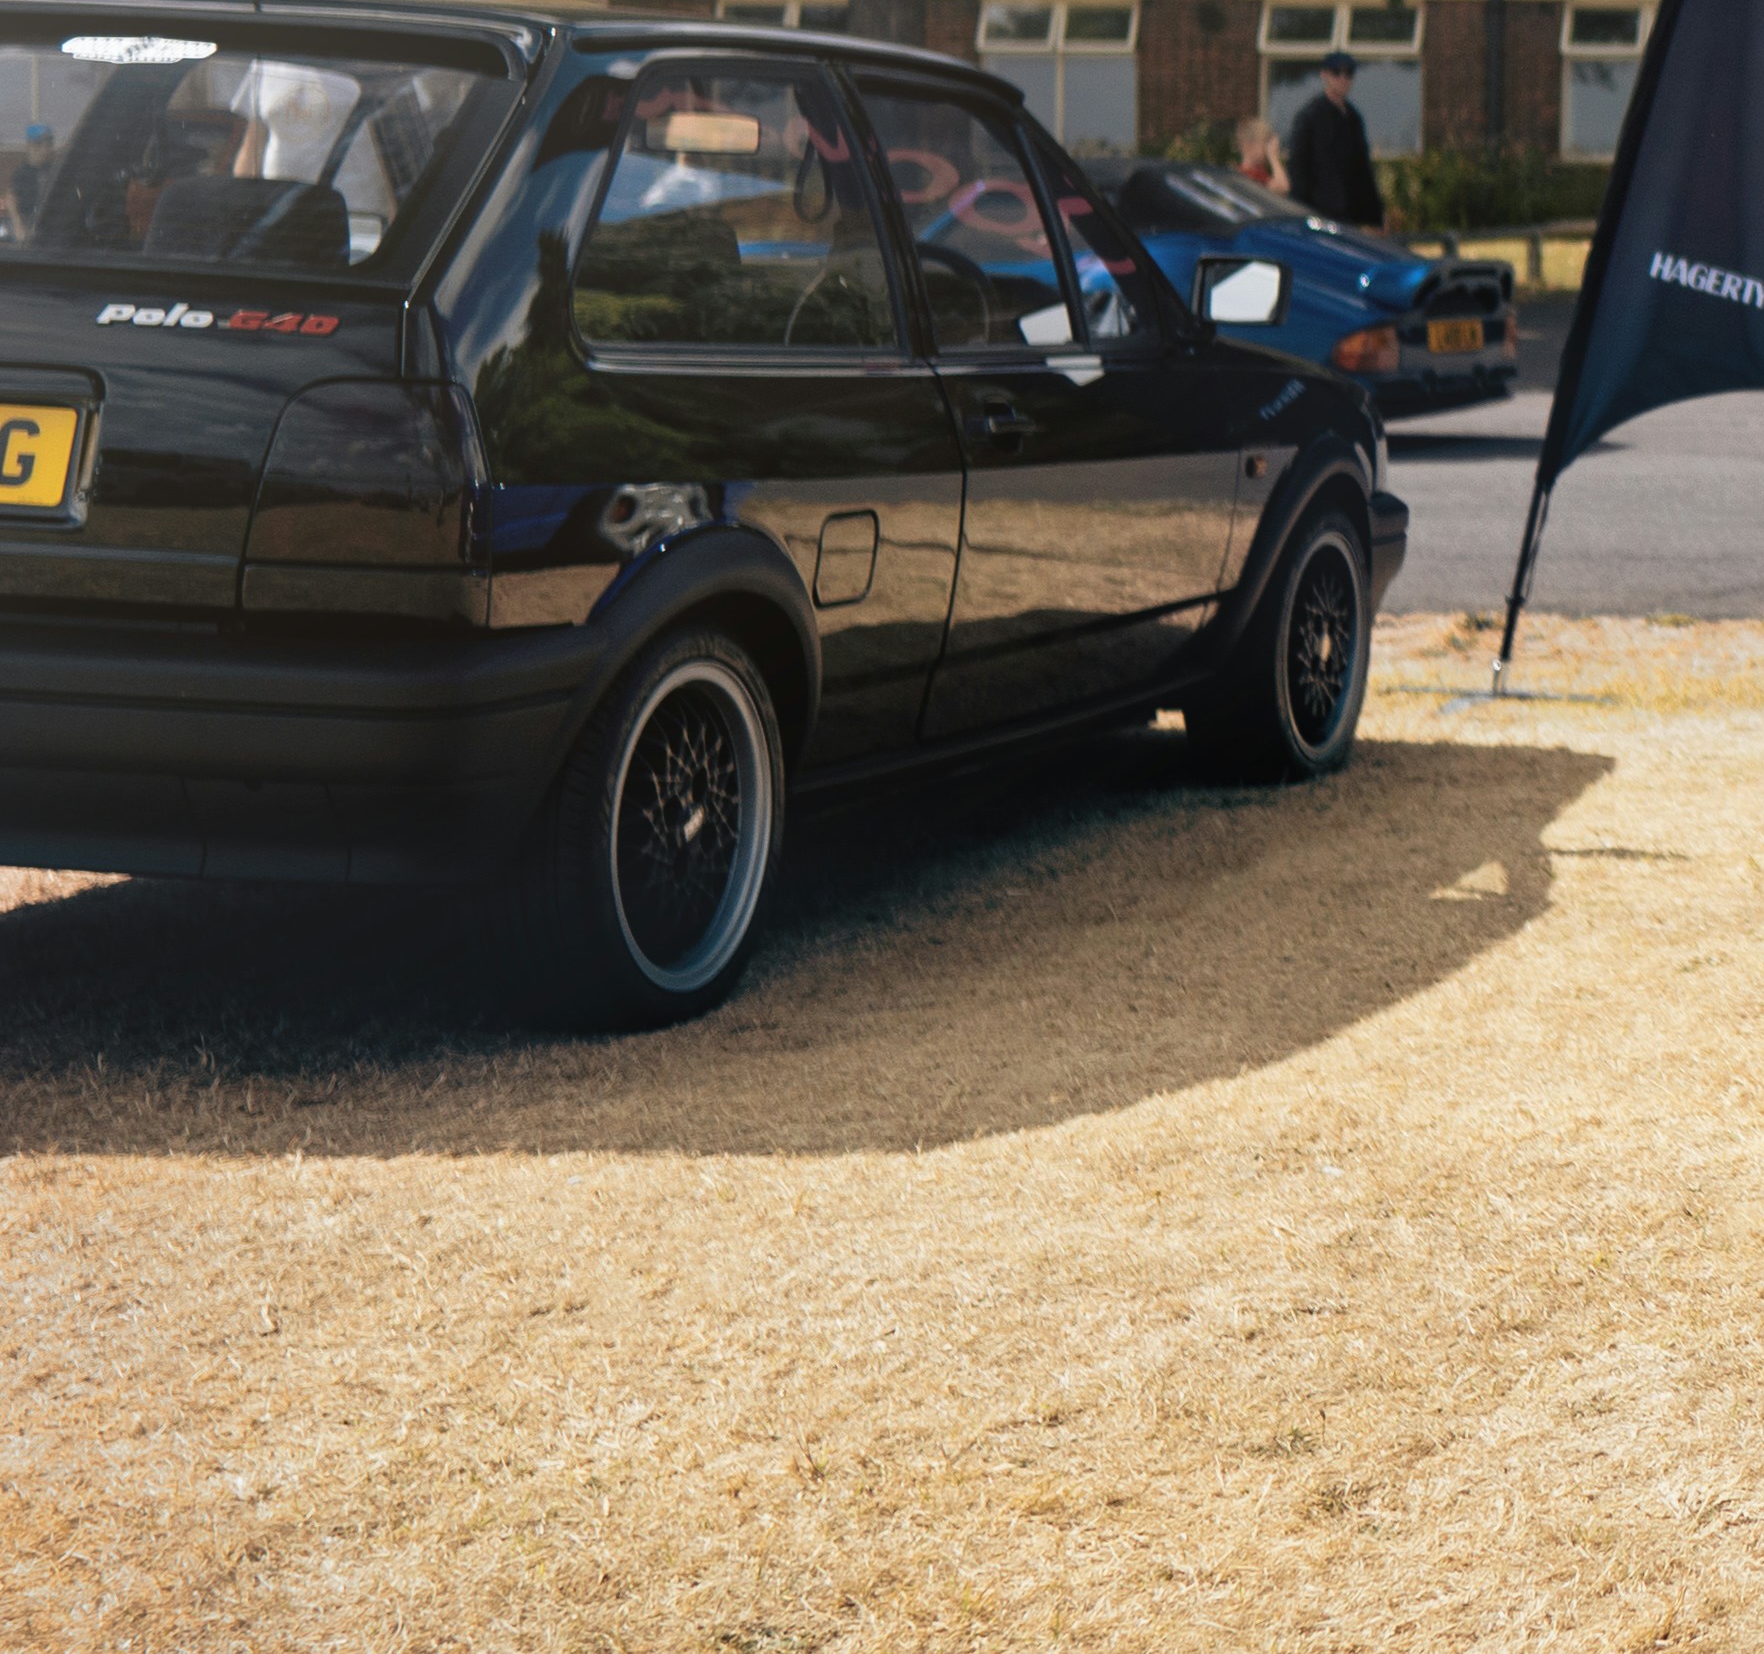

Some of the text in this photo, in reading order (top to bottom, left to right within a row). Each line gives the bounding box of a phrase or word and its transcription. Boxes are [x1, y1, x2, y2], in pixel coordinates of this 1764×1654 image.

[96, 302, 340, 335] Polo G40
[0, 417, 41, 486] G
